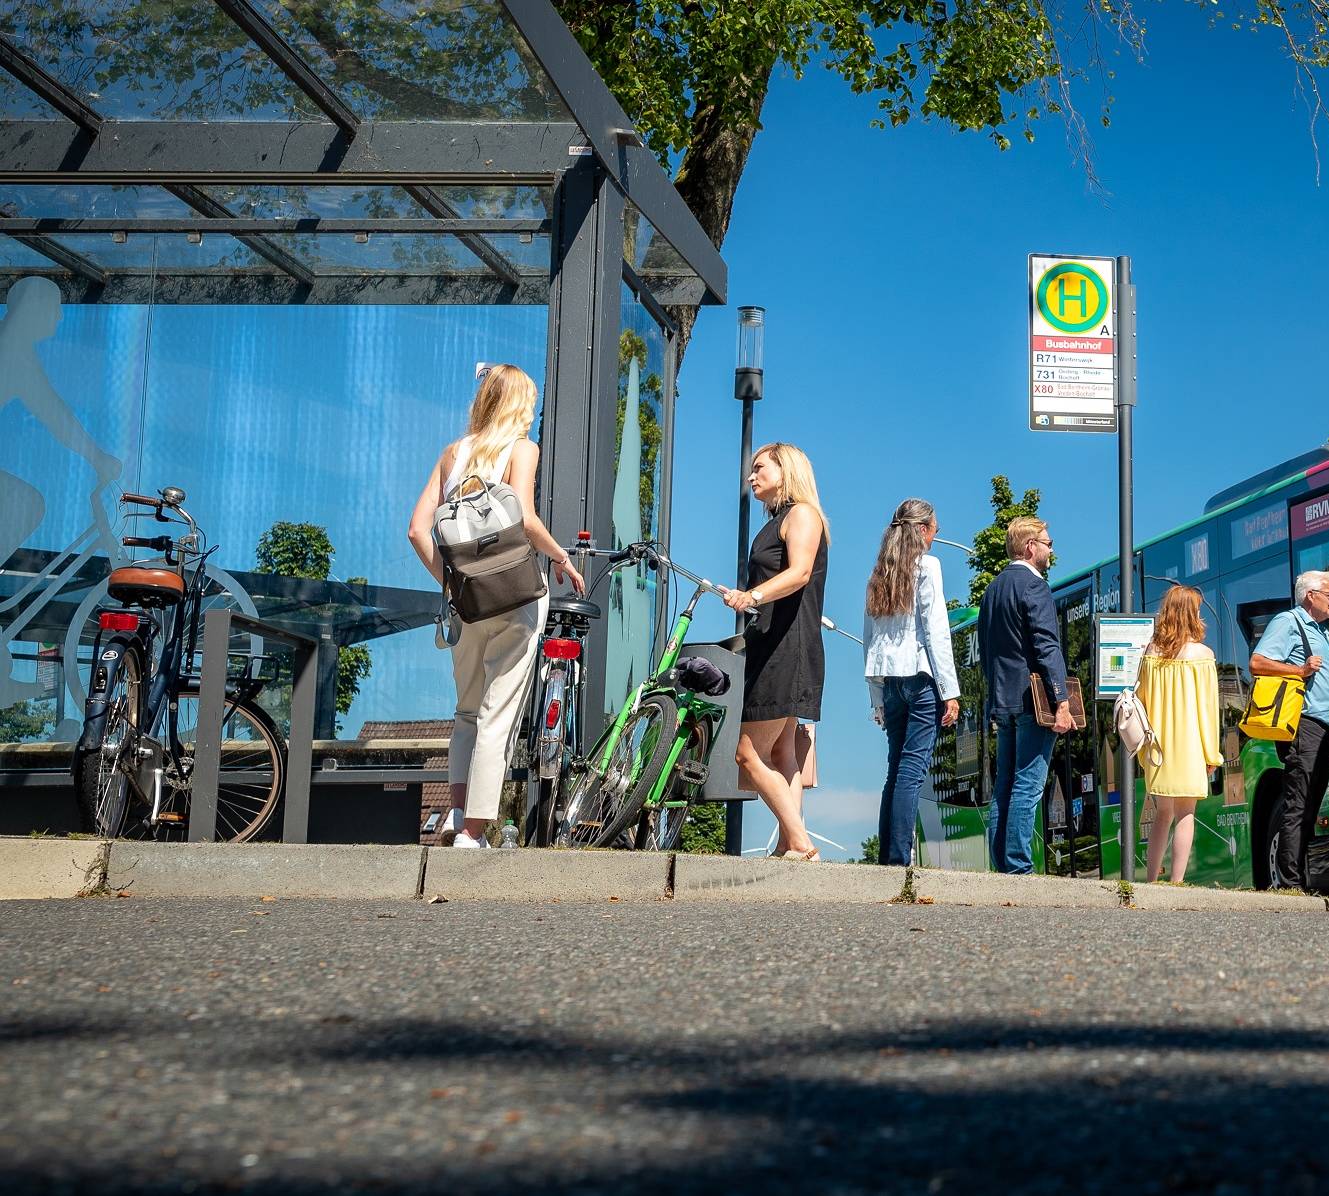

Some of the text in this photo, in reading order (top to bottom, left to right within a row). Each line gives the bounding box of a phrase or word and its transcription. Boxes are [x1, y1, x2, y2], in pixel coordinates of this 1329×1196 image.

[1058, 278, 1086, 317] H
[1100, 325, 1110, 336] A
[1045, 339, 1102, 350] Busbahnhof
[1036, 353, 1057, 364] R71
[1036, 370, 1055, 380] 731
[1034, 384, 1054, 394] X80
[1066, 589, 1120, 623] unsere Region
